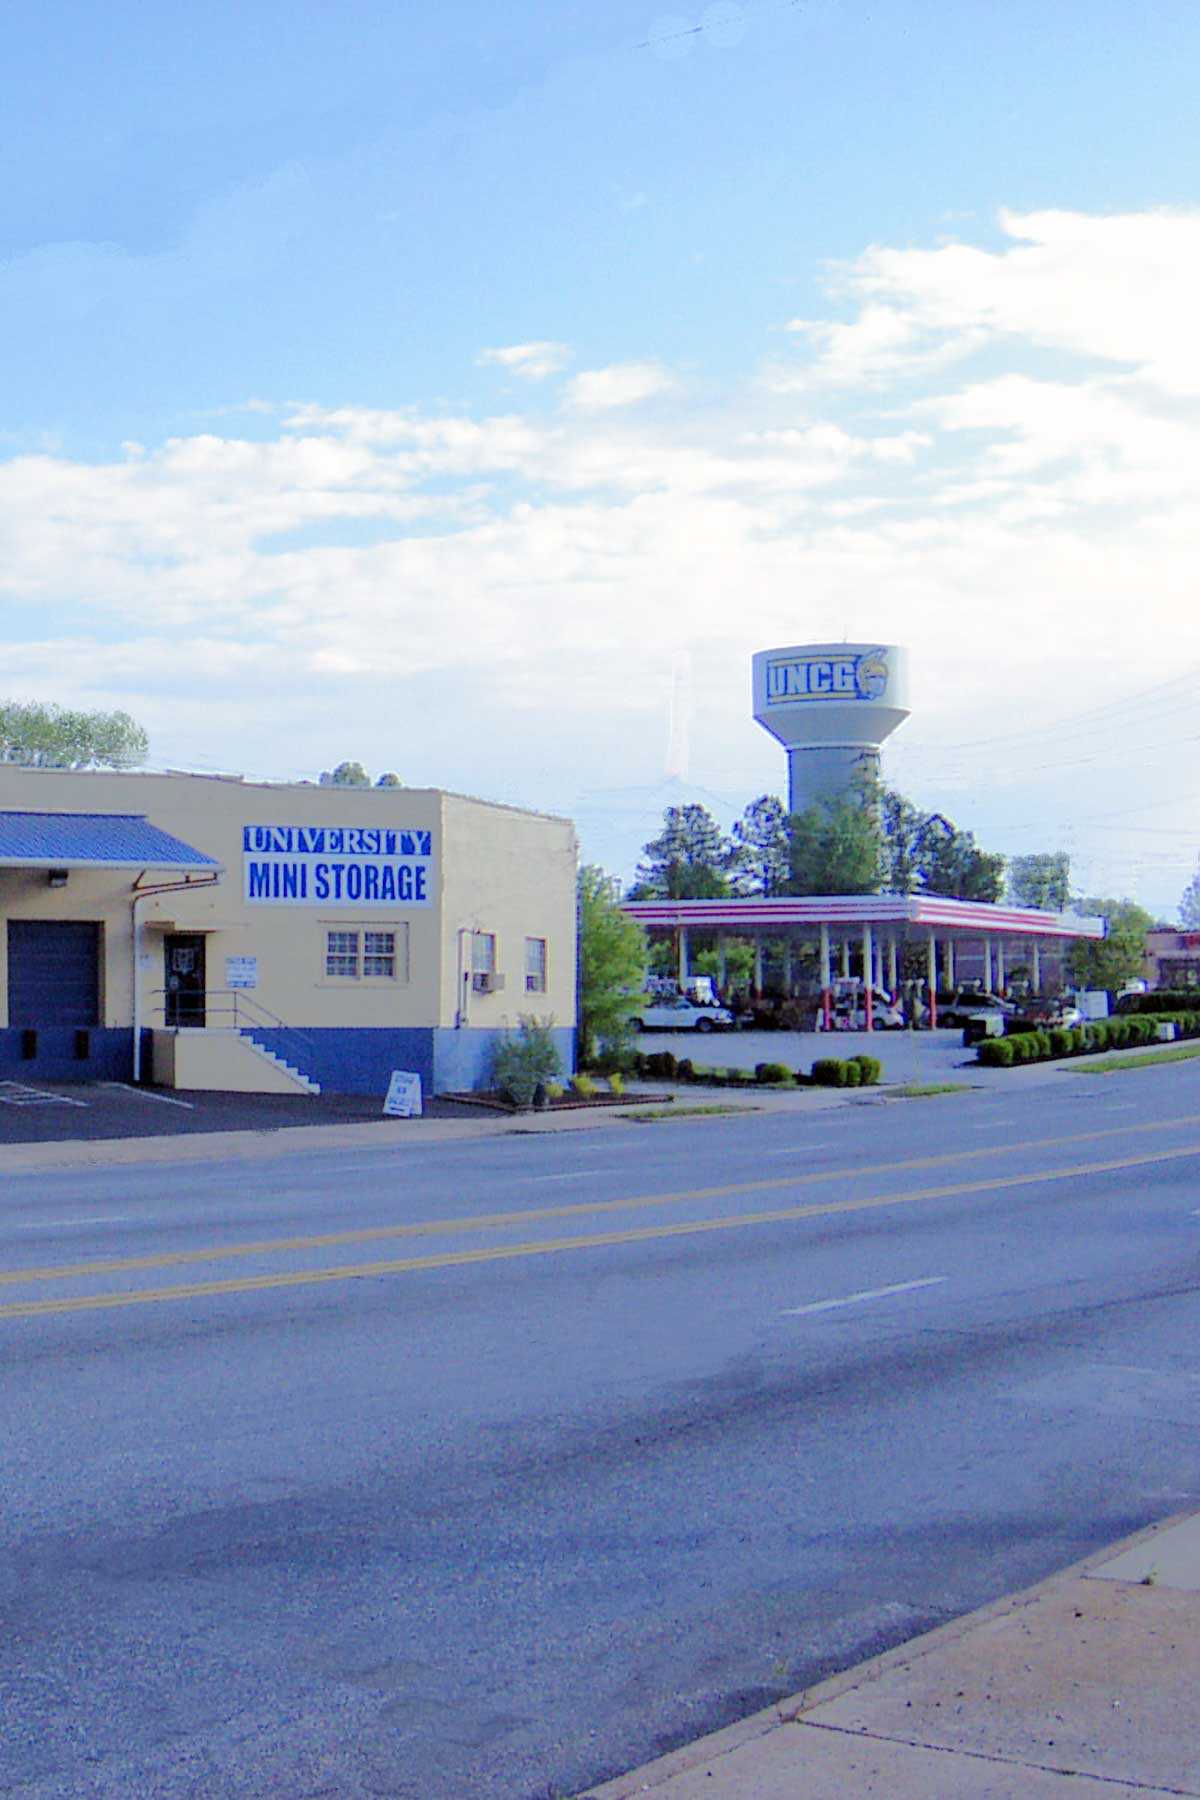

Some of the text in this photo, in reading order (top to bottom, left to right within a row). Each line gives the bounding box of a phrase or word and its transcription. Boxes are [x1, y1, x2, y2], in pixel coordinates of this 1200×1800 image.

[767, 661, 856, 697] UNCG
[248, 827, 429, 855] UNIVERSITY
[249, 862, 427, 901] MINI STORAGE
